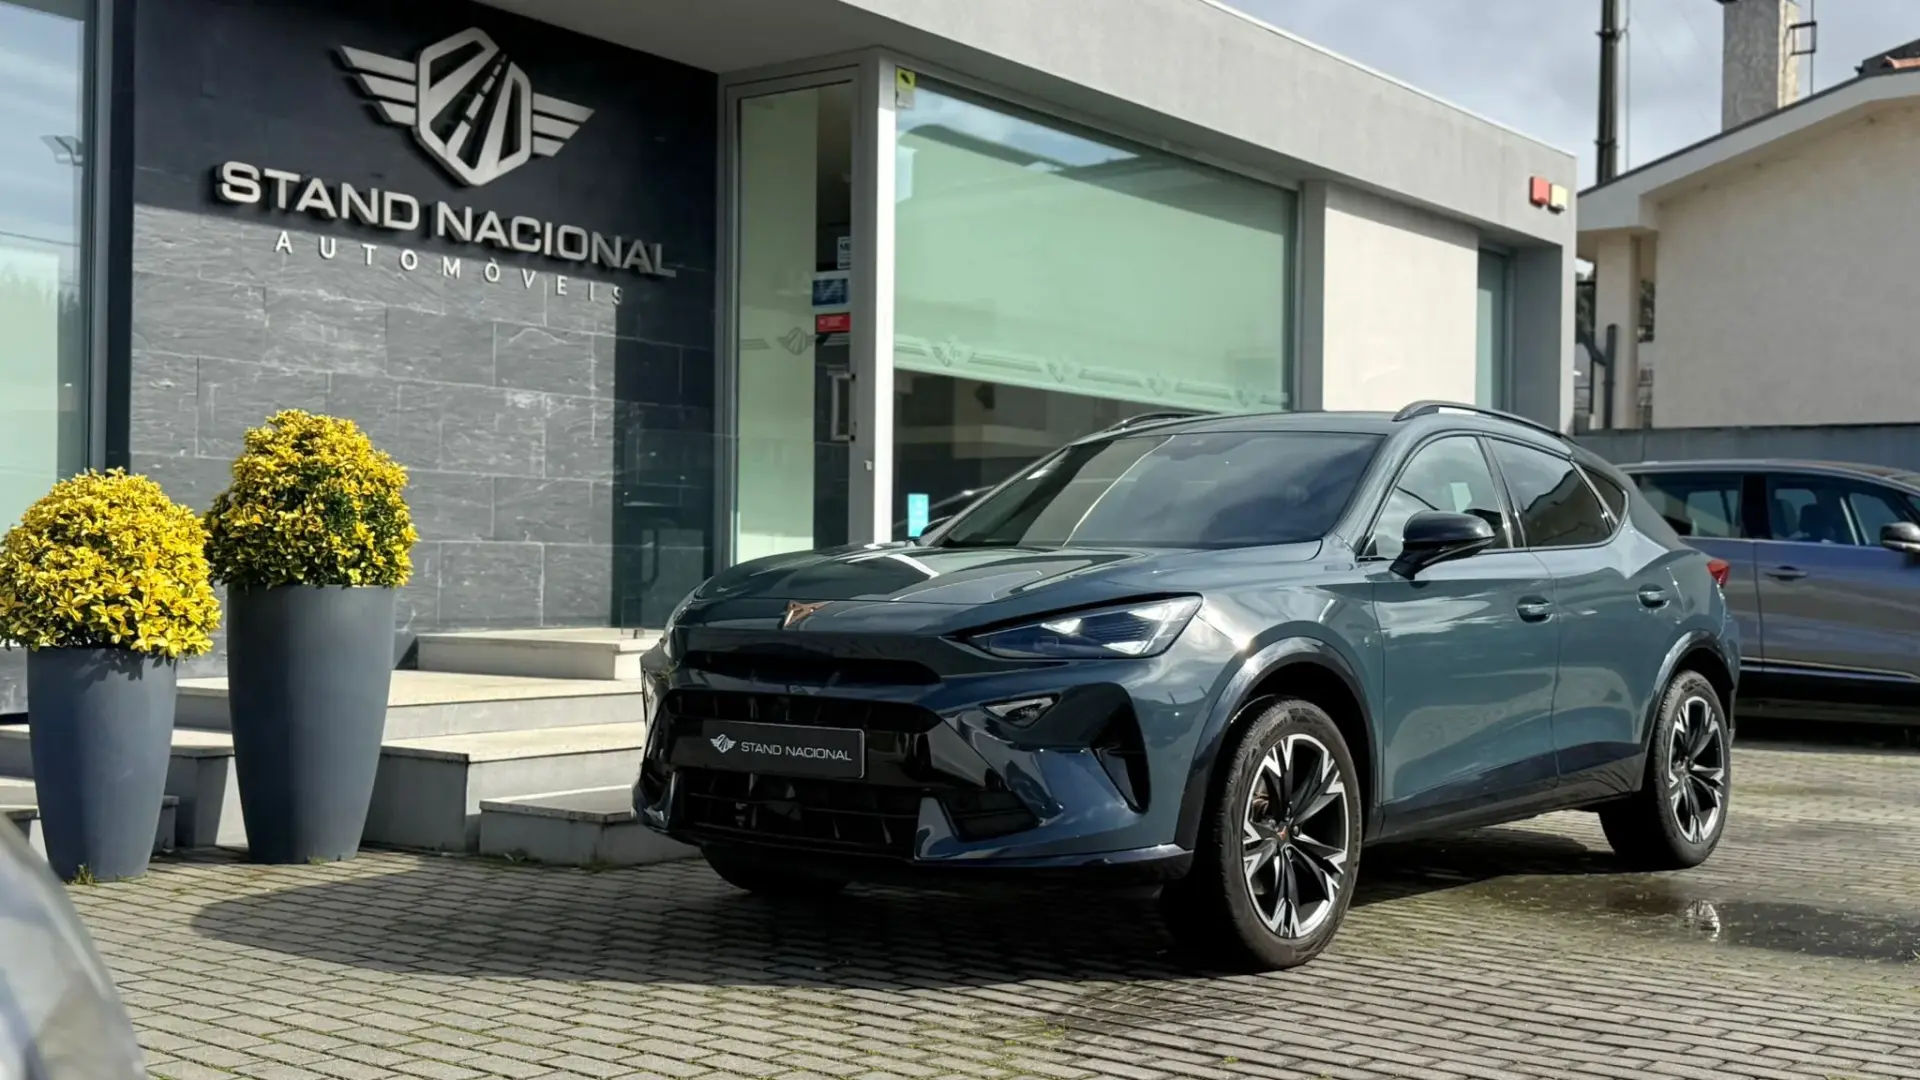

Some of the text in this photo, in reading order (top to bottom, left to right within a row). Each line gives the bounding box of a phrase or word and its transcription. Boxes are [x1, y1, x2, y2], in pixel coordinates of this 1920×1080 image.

[216, 161, 677, 277] STAND NACIONAL
[740, 741, 853, 761] STAND NACIONAL
